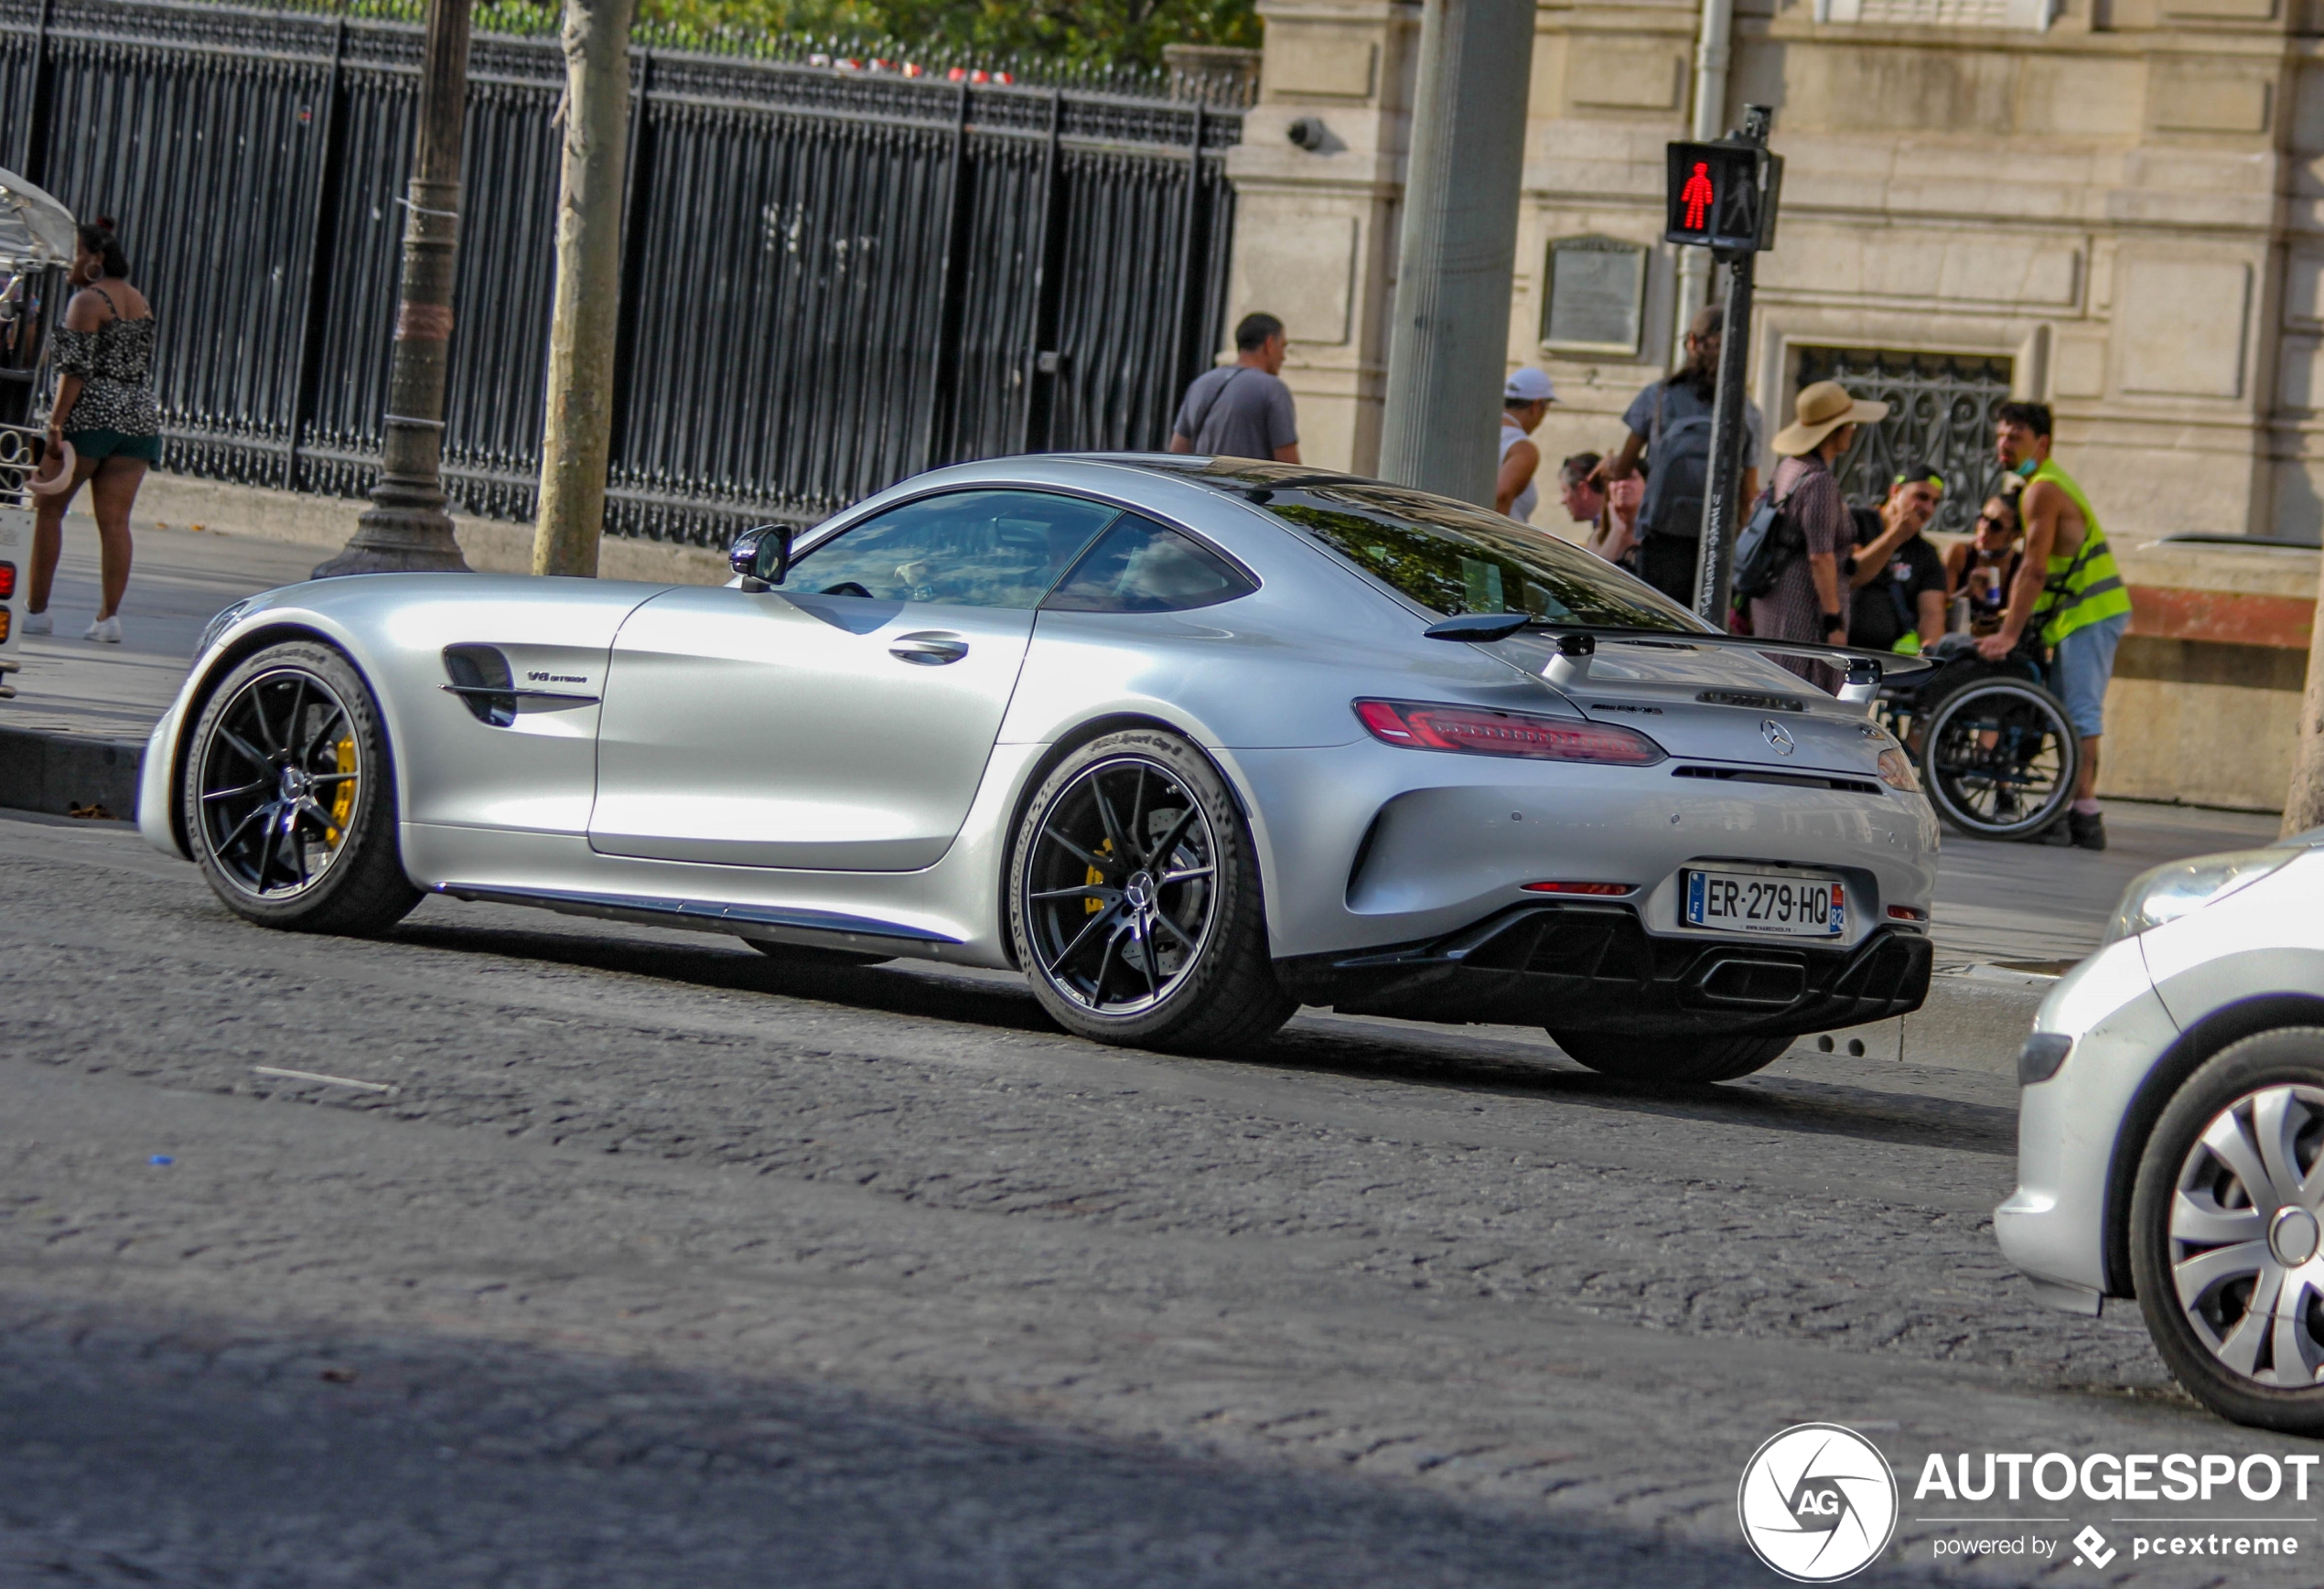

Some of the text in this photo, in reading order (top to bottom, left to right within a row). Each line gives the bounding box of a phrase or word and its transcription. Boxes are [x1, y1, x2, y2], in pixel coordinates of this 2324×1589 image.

[1011, 818, 1032, 909] MICHELIN
[1694, 902, 1699, 912] F
[1708, 879, 1827, 924] ER-279-HQ
[1831, 908, 1843, 926] 82
